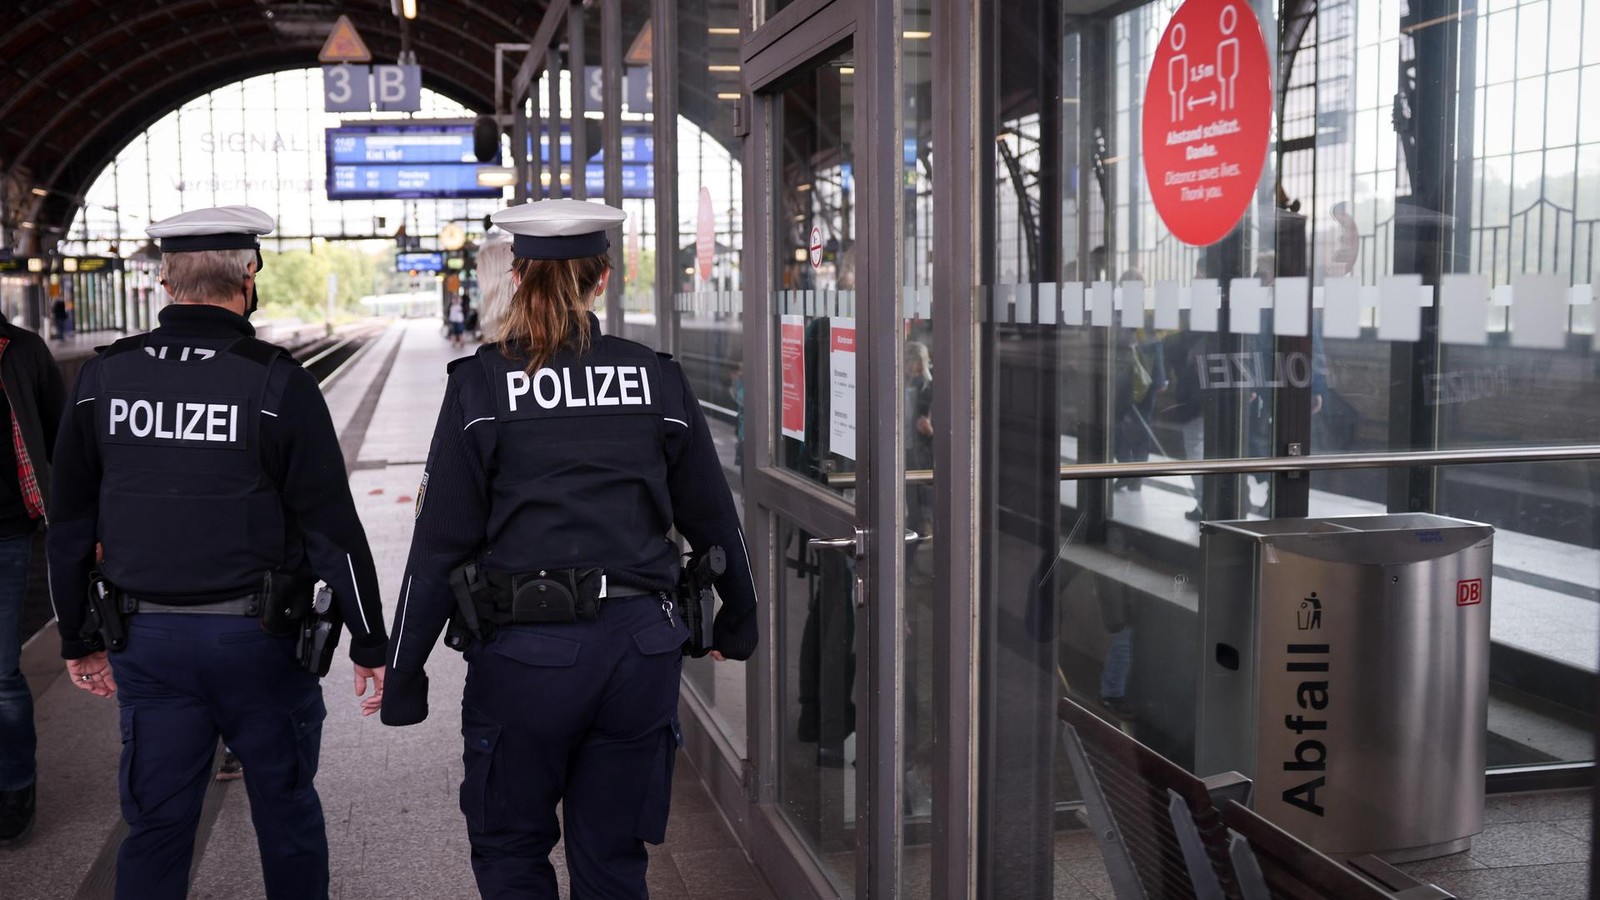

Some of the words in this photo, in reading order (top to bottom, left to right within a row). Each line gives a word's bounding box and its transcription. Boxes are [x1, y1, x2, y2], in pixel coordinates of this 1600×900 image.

[328, 66, 352, 104] 3
[380, 65, 406, 102] B
[200, 131, 303, 153] SIGNAL
[1166, 126, 1203, 146] Abstand
[1203, 119, 1241, 139] schützt.
[1186, 143, 1218, 161] Danke.
[1165, 171, 1196, 186] Distance
[1198, 166, 1219, 181] saves
[1220, 162, 1241, 177] lives.
[1181, 188, 1205, 201] Thank
[1206, 186, 1223, 202] you.
[506, 365, 652, 412] POLIZEI
[109, 398, 238, 442] POLIZEI
[1458, 582, 1480, 604] DB
[1282, 644, 1330, 818] Abfall
